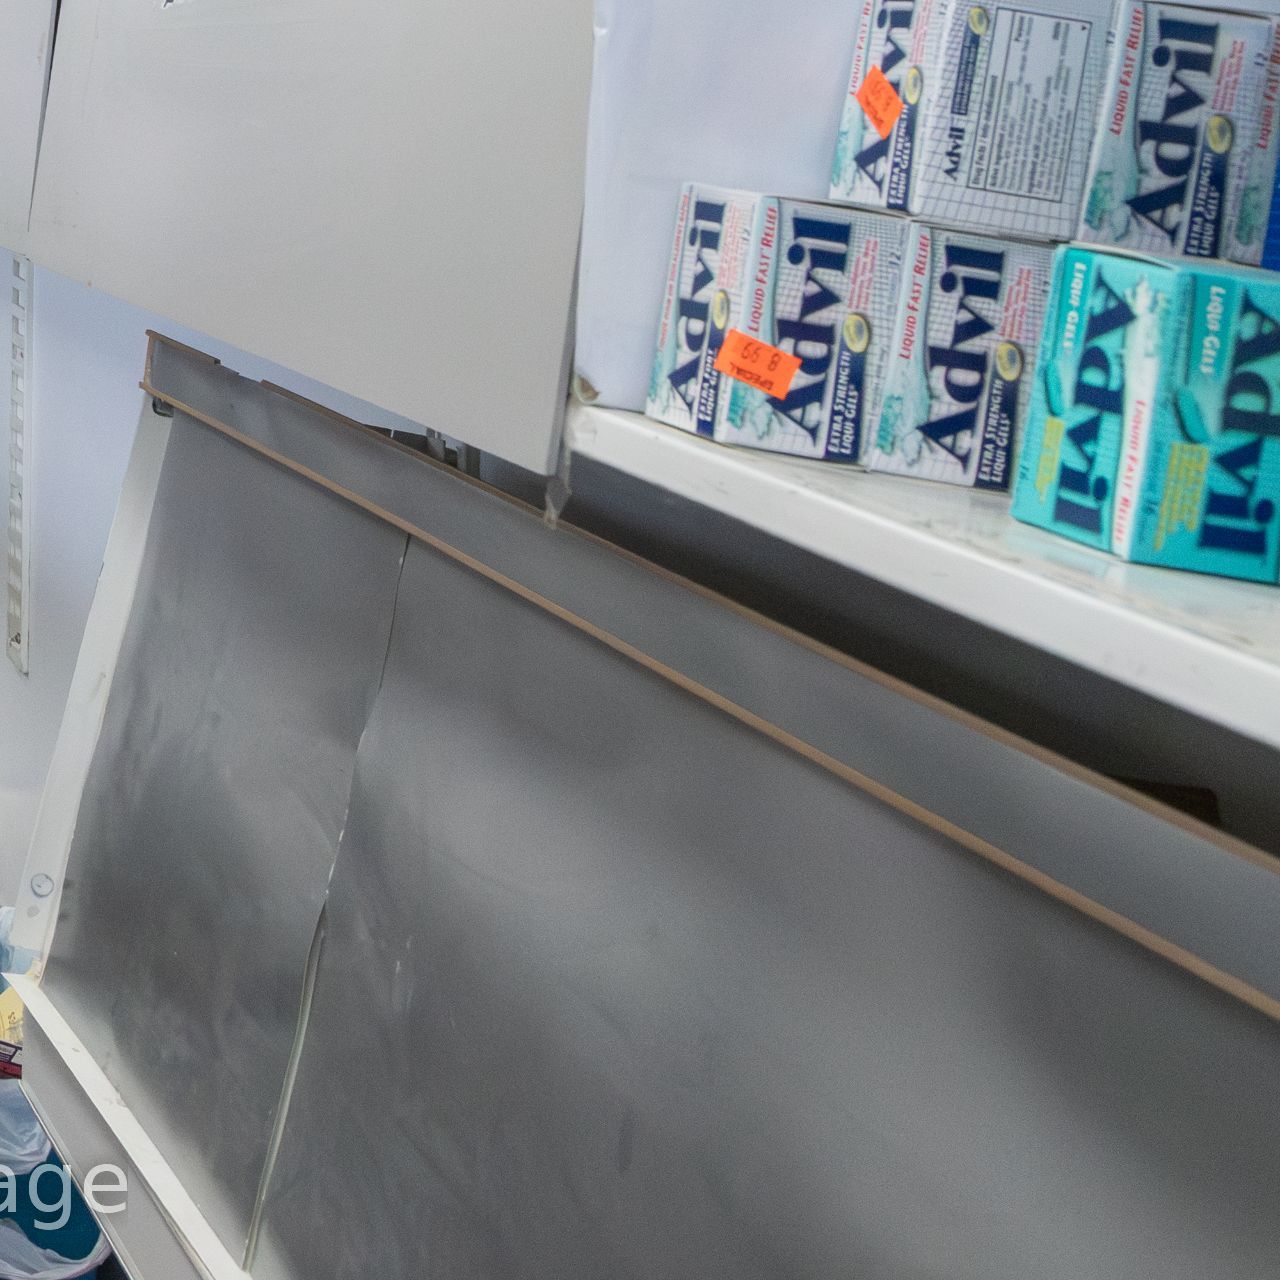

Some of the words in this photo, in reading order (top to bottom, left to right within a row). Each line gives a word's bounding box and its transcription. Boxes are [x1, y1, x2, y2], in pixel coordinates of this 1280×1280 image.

[1126, 8, 1144, 50] RELIEF
[1120, 58, 1135, 87] FAST
[1109, 93, 1128, 136] LIQUID
[1125, 10, 1220, 248] Advil
[944, 126, 965, 181] Advil
[761, 206, 778, 249] RELIEF
[756, 253, 771, 283] FAST
[913, 234, 930, 278] RELIEF
[667, 200, 726, 415] Advil
[748, 283, 765, 333] LIQUID
[908, 281, 924, 313] FAST
[767, 209, 851, 447] Advil
[899, 315, 917, 360] LIQUID
[835, 351, 851, 410] STRENGTH
[916, 238, 1004, 474] Advil
[1053, 265, 1138, 534] Advil
[1197, 288, 1280, 556] Advil
[828, 411, 844, 453] EXTRA
[978, 440, 996, 482] EXTRA
[987, 379, 1004, 439] STRENGTH
